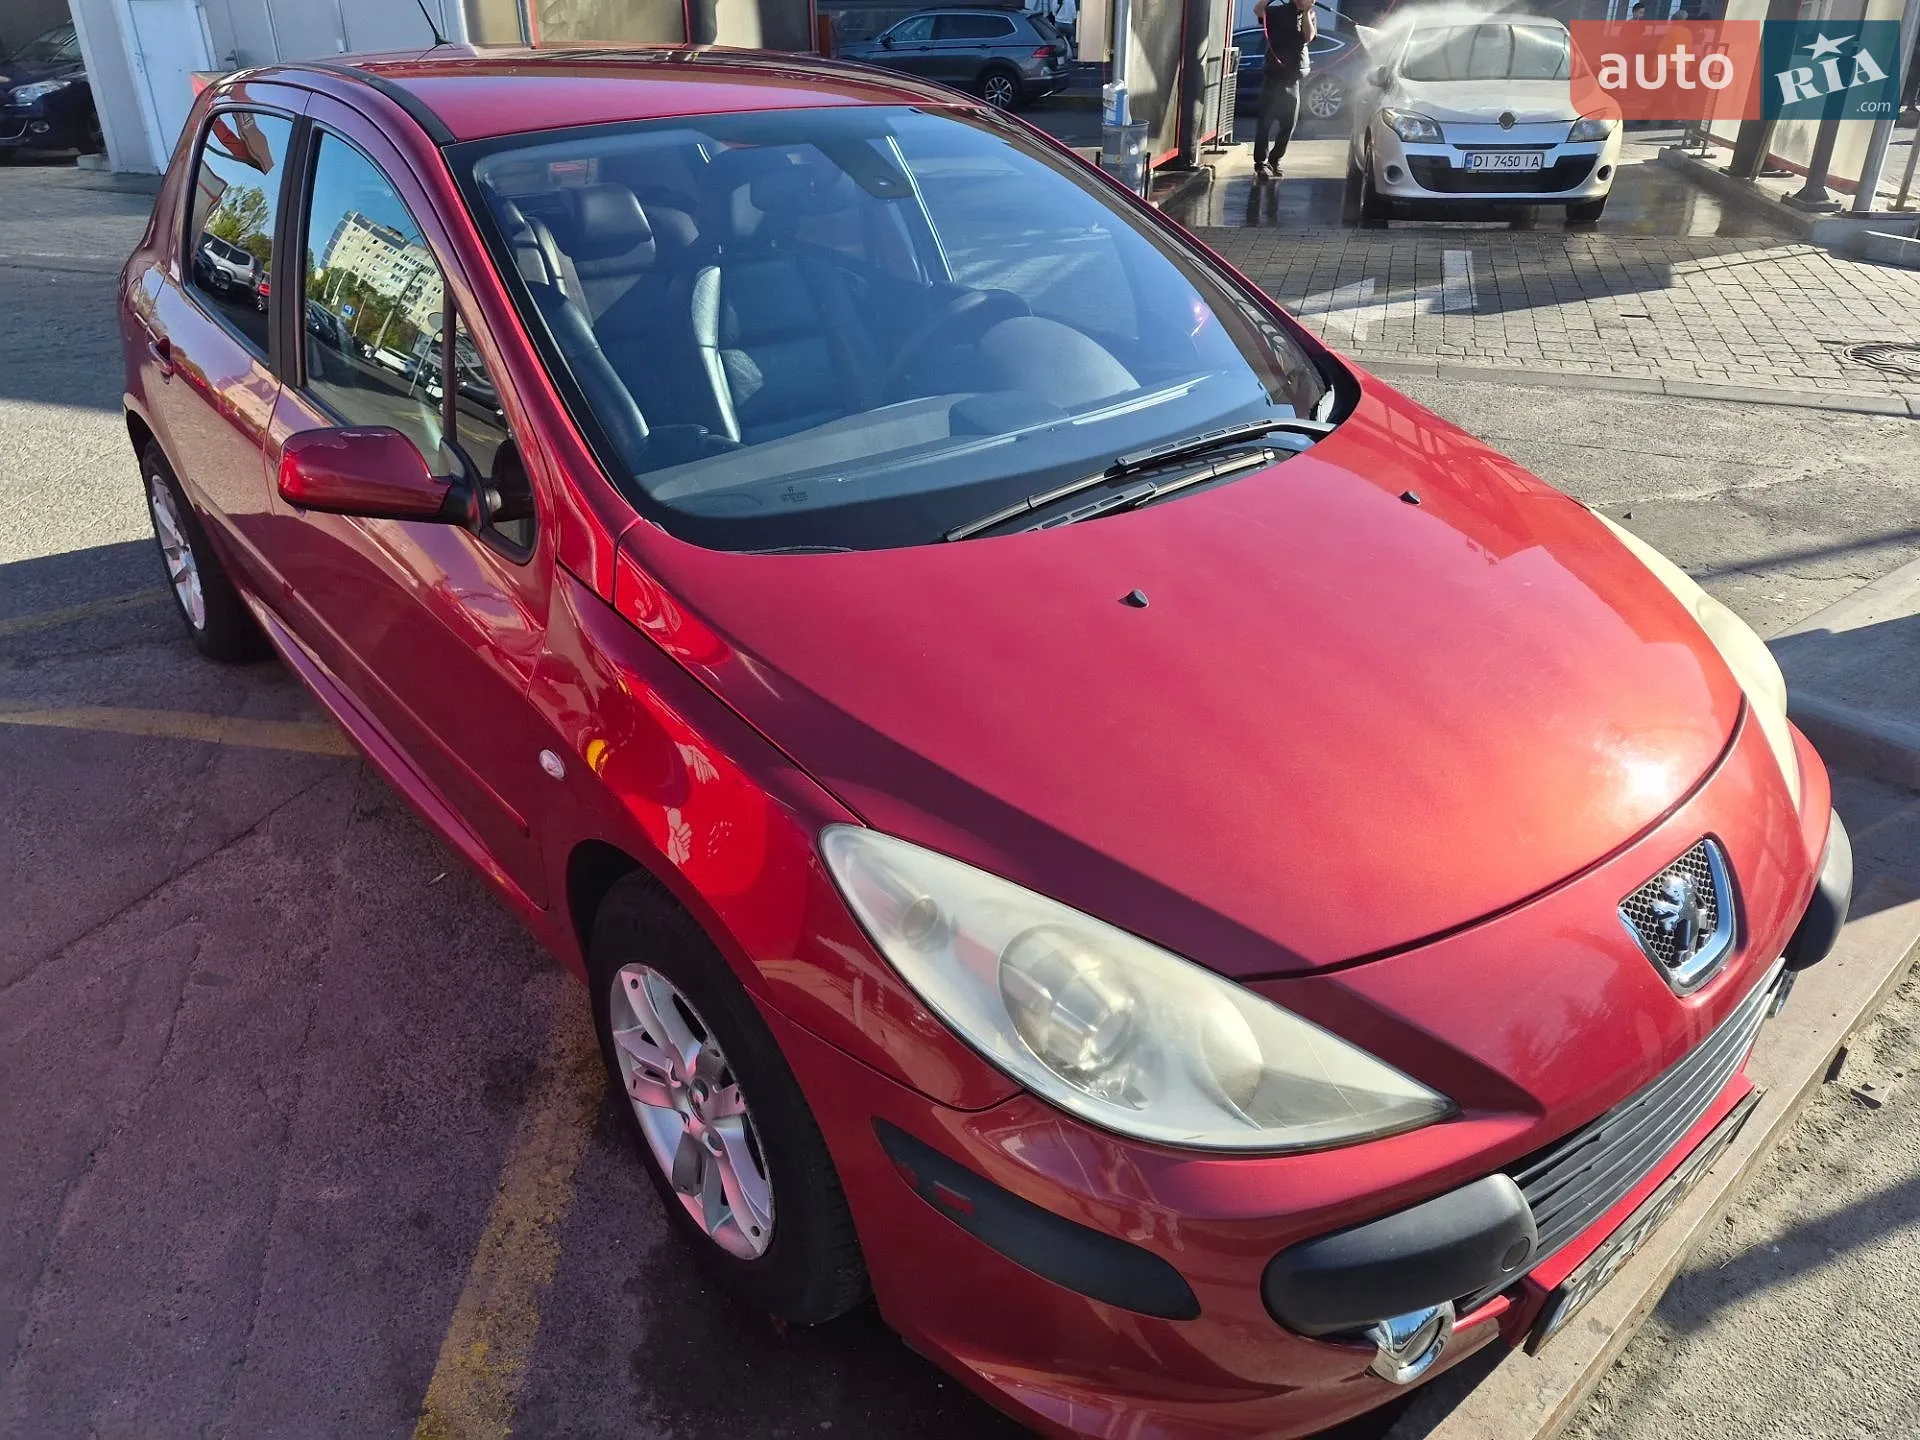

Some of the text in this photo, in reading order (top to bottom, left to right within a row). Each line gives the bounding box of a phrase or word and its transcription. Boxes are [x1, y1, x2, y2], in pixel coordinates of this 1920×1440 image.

[1473, 155, 1539, 167] DI 7450 IA
